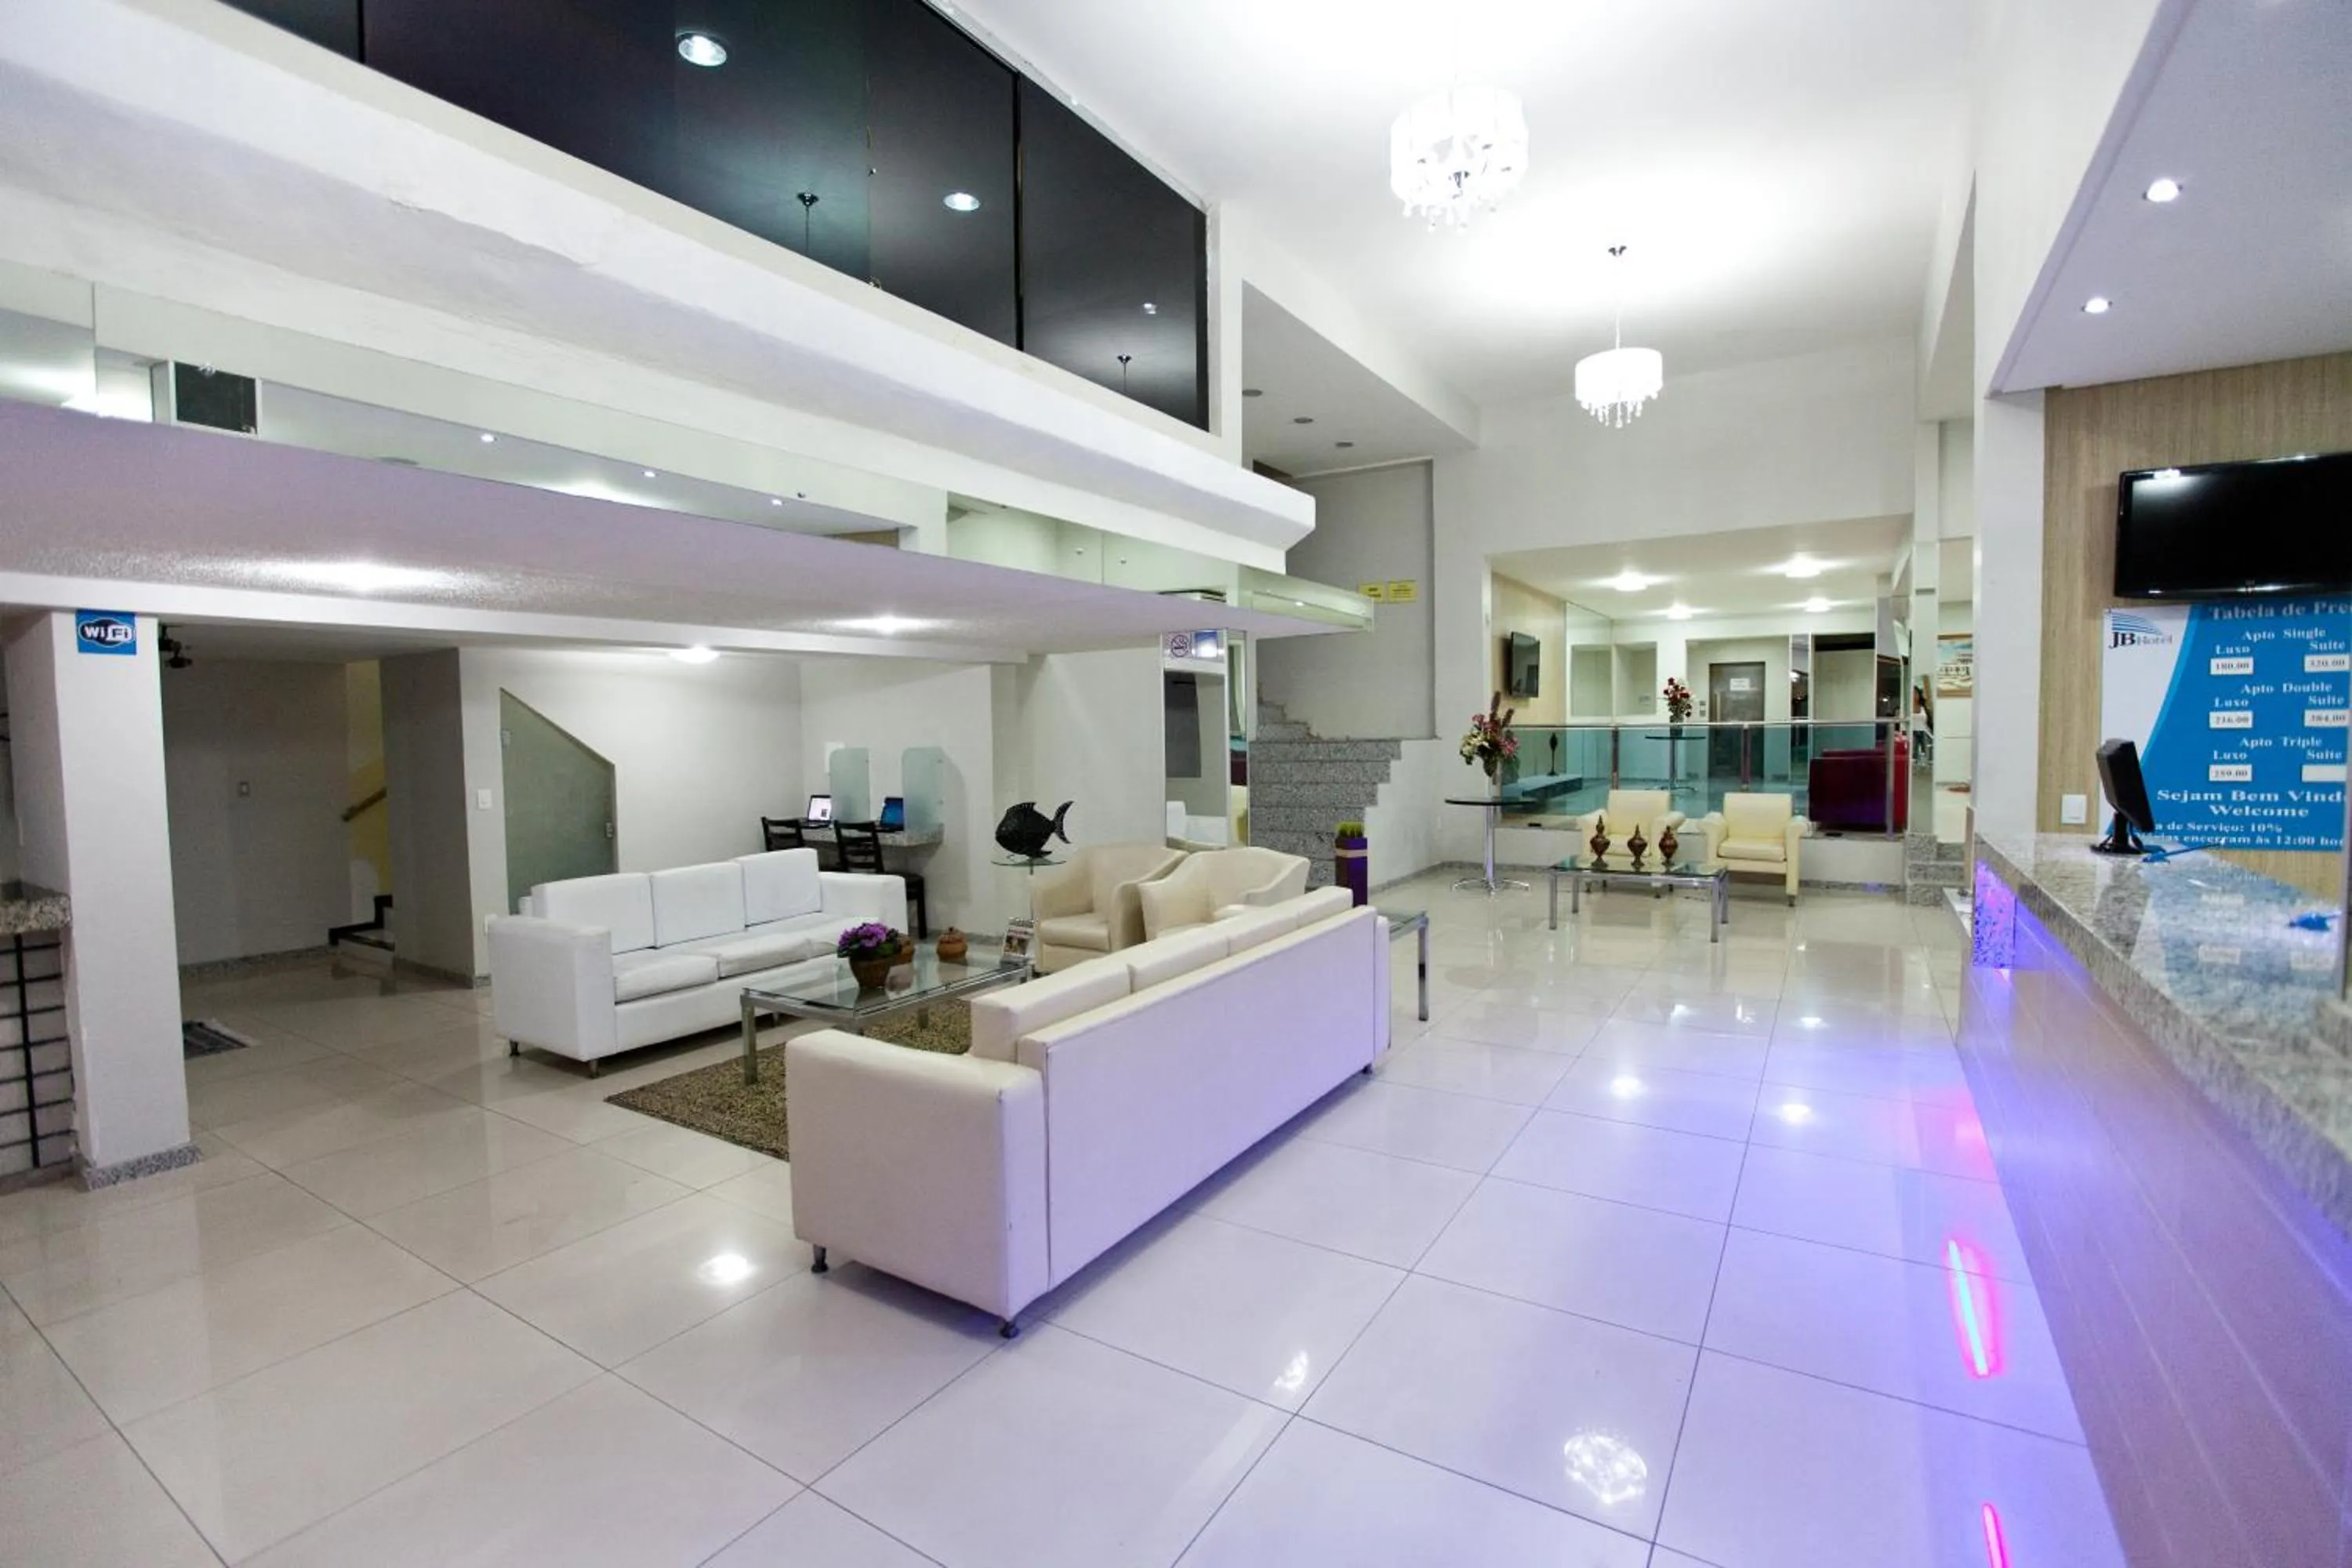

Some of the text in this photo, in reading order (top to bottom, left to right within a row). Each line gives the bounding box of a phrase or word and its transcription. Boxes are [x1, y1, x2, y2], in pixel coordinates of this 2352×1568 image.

[2209, 604, 2274, 621] Tabela
[2281, 603, 2306, 616] de
[2242, 627, 2326, 643] Apto Single
[2215, 644, 2250, 655] Luxo
[2309, 640, 2346, 651] Suite
[2241, 681, 2332, 696] Apto Double
[2214, 697, 2249, 707] Luxo
[2308, 695, 2345, 706] Suite
[2239, 736, 2323, 749] Apto Triple
[2213, 750, 2248, 760] Luxo
[2307, 749, 2343, 760] Suite
[2157, 789, 2222, 803] Sejam
[2232, 789, 2279, 801] Bem
[2209, 804, 2309, 818] Welcome
[2167, 821, 2183, 830] de
[2251, 822, 2283, 833] 10%
[2277, 835, 2315, 845] 12:00
